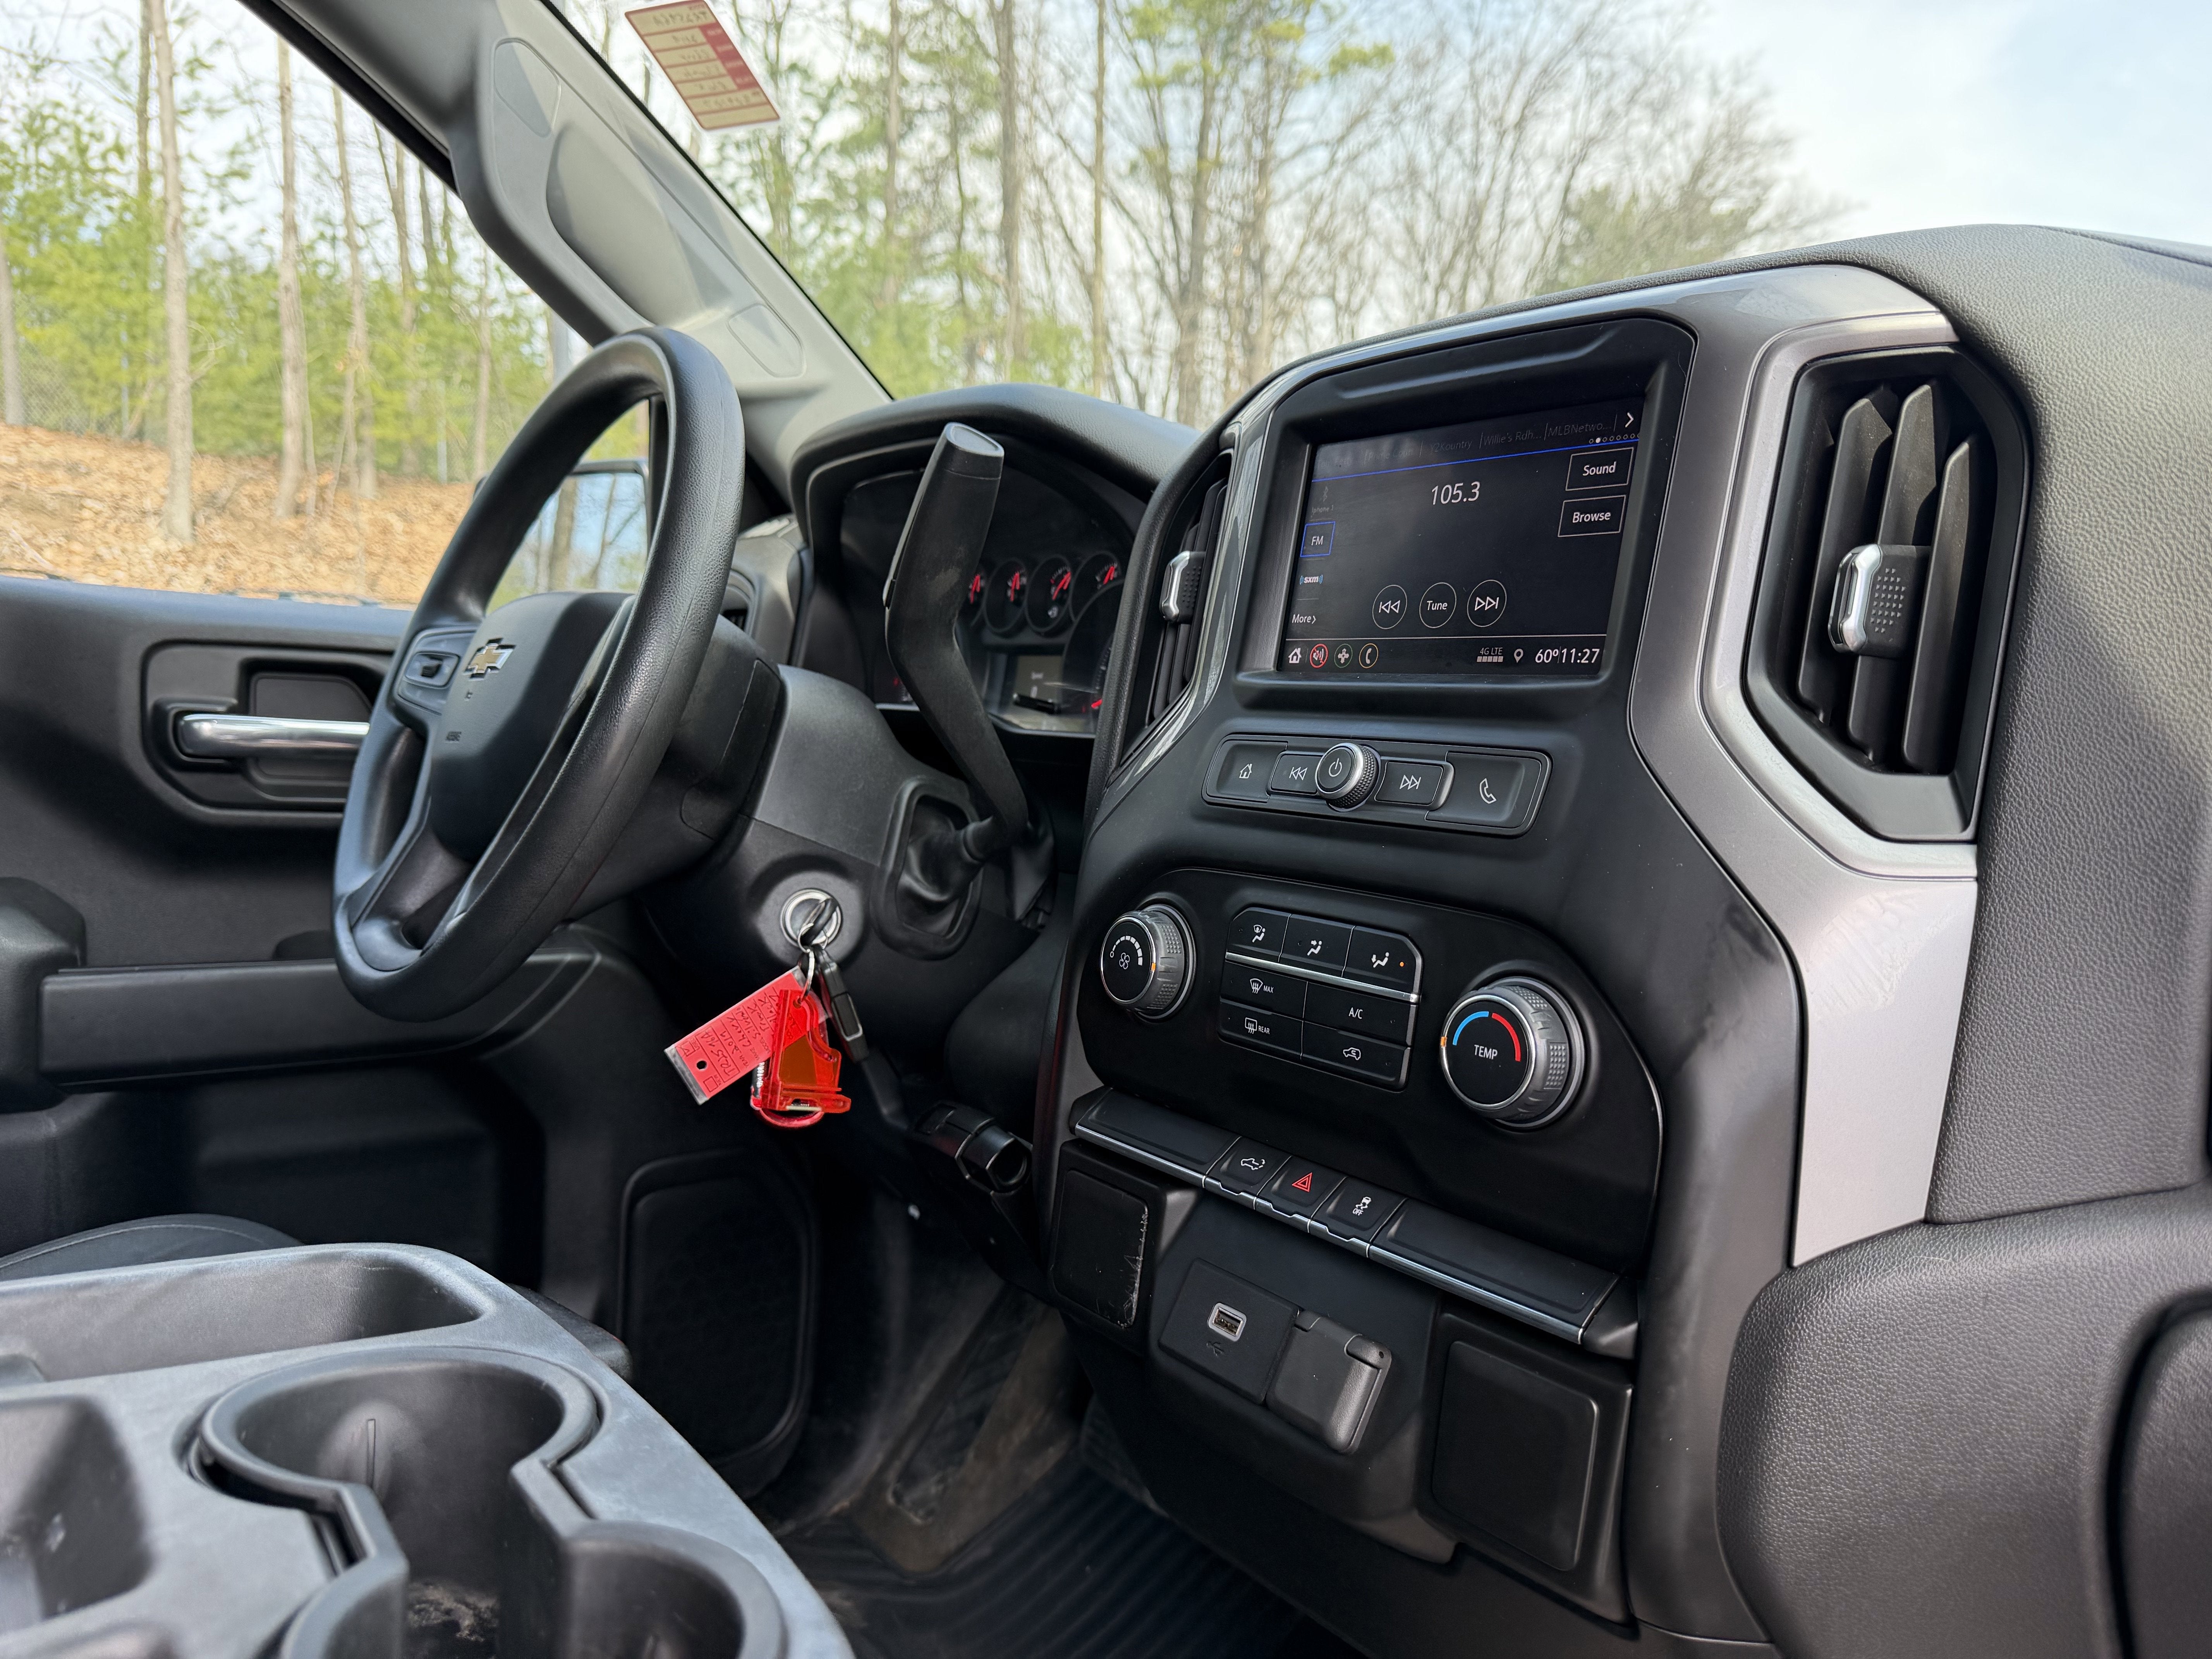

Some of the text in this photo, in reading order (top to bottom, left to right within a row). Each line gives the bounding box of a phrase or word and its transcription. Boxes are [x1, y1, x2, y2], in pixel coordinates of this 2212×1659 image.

[1483, 433, 1511, 446] Willie's
[1431, 440, 1472, 454] Y2Kountry
[1582, 461, 1617, 476] Sound
[1431, 481, 1480, 505] 105.3
[1572, 511, 1611, 523] Browse
[1311, 536, 1324, 546] FM
[1427, 601, 1448, 611] Tune
[1561, 648, 1600, 663] 11:27
[1263, 985, 1274, 994] MAX
[1348, 1007, 1363, 1020] A/C
[1258, 1026, 1270, 1035] REAR
[1474, 1044, 1498, 1060] TEMP
[1352, 1208, 1364, 1216] OFF
